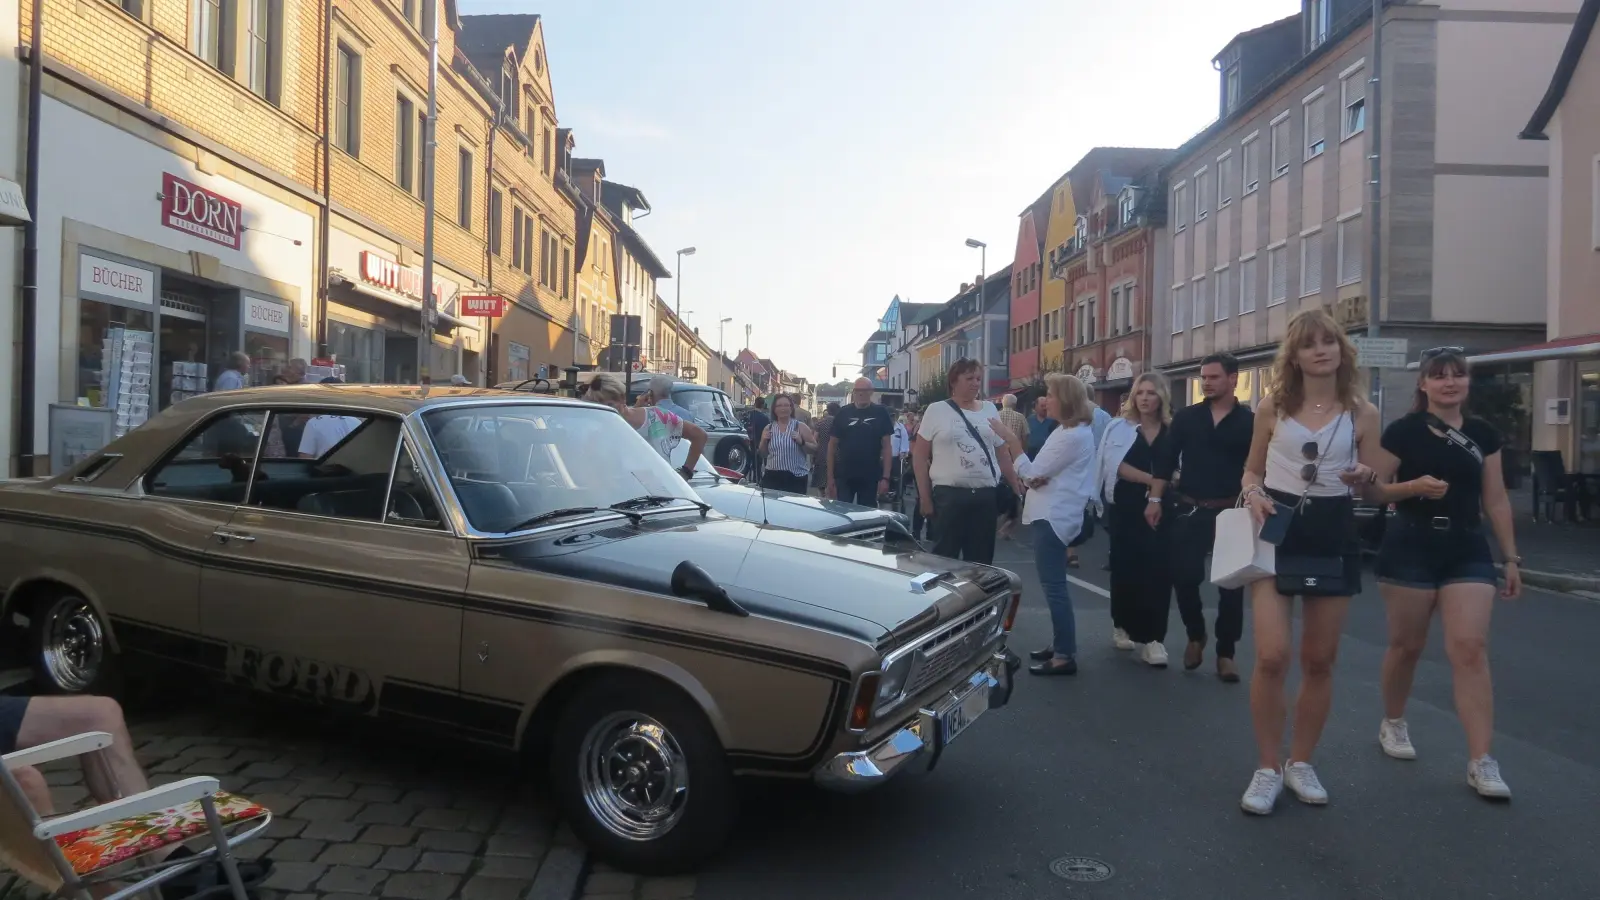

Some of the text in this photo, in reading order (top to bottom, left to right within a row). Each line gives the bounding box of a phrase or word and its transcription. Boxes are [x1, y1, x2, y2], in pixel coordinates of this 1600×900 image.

[173, 181, 238, 235] DORN
[92, 266, 143, 293] BÜCHER
[363, 251, 399, 290] WITT
[251, 305, 283, 323] BÜCHER
[467, 299, 497, 310] WITT
[224, 641, 379, 714] FORD
